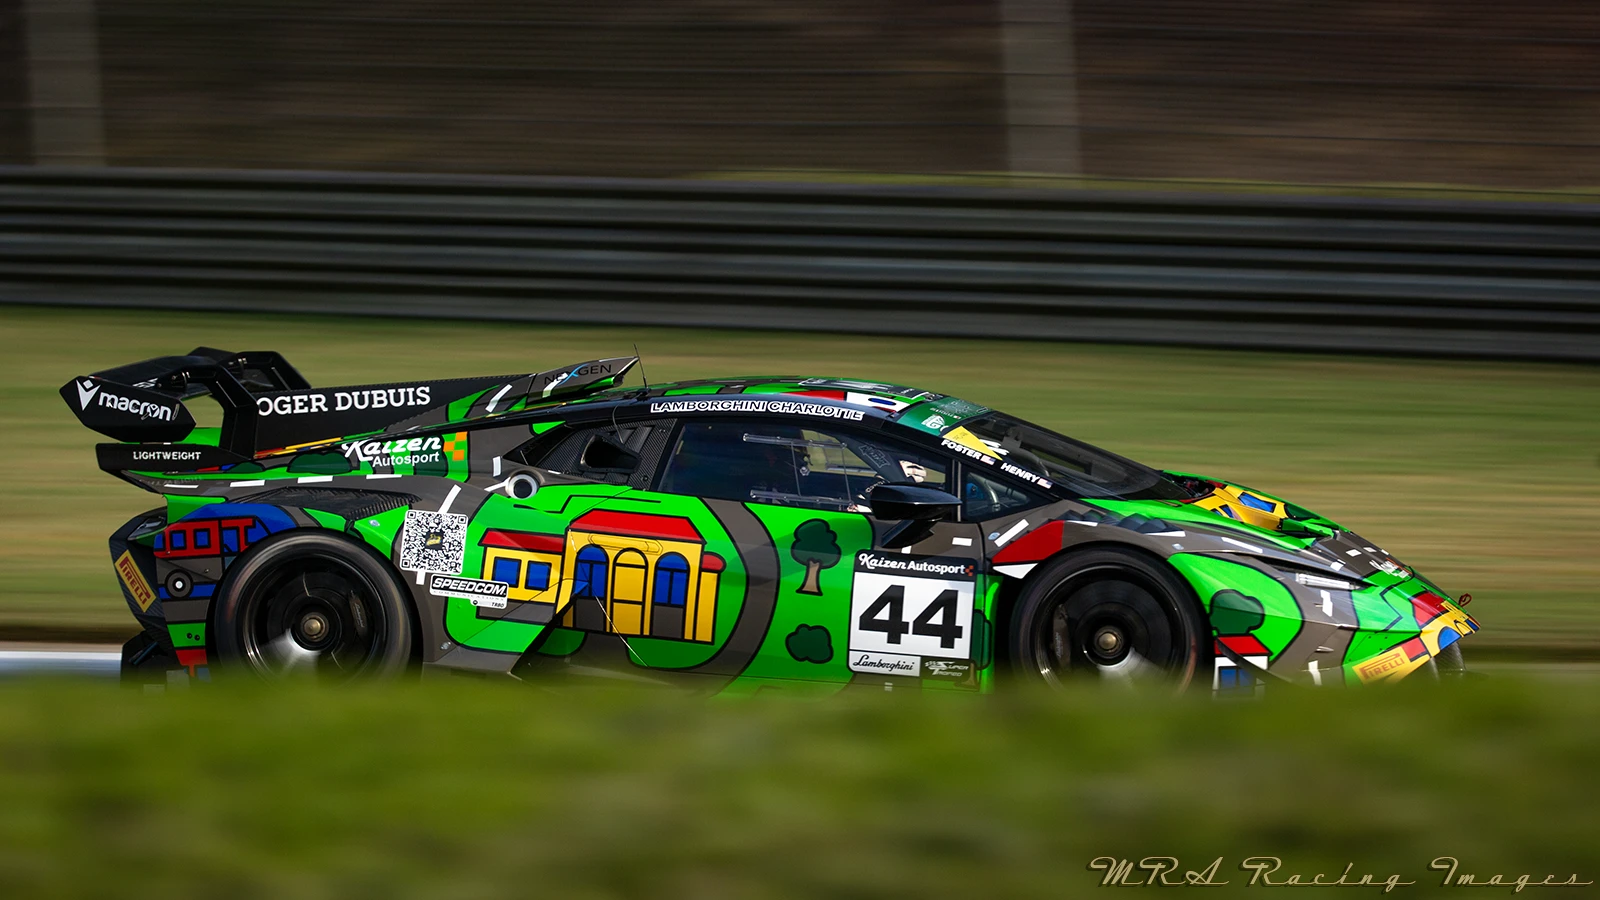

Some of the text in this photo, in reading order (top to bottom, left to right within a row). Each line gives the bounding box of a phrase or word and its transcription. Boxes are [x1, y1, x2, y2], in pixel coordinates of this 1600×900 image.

[99, 391, 172, 421] macron
[256, 386, 430, 416] OGER DUBUIS
[651, 400, 865, 421] LAMBORGHINI CHARLOTTE
[133, 451, 201, 460] LIGHTWEIGHT
[341, 437, 441, 462] Kaizen
[372, 451, 439, 467] Autosport
[941, 439, 982, 460] FOSTER
[1000, 462, 1040, 484] HENRY
[859, 553, 965, 575] Kaizen Autosport
[118, 556, 151, 605] PIRELLI
[859, 584, 963, 649] 44
[853, 654, 914, 671] Lamborghini
[1359, 653, 1405, 679] PIRELLI
